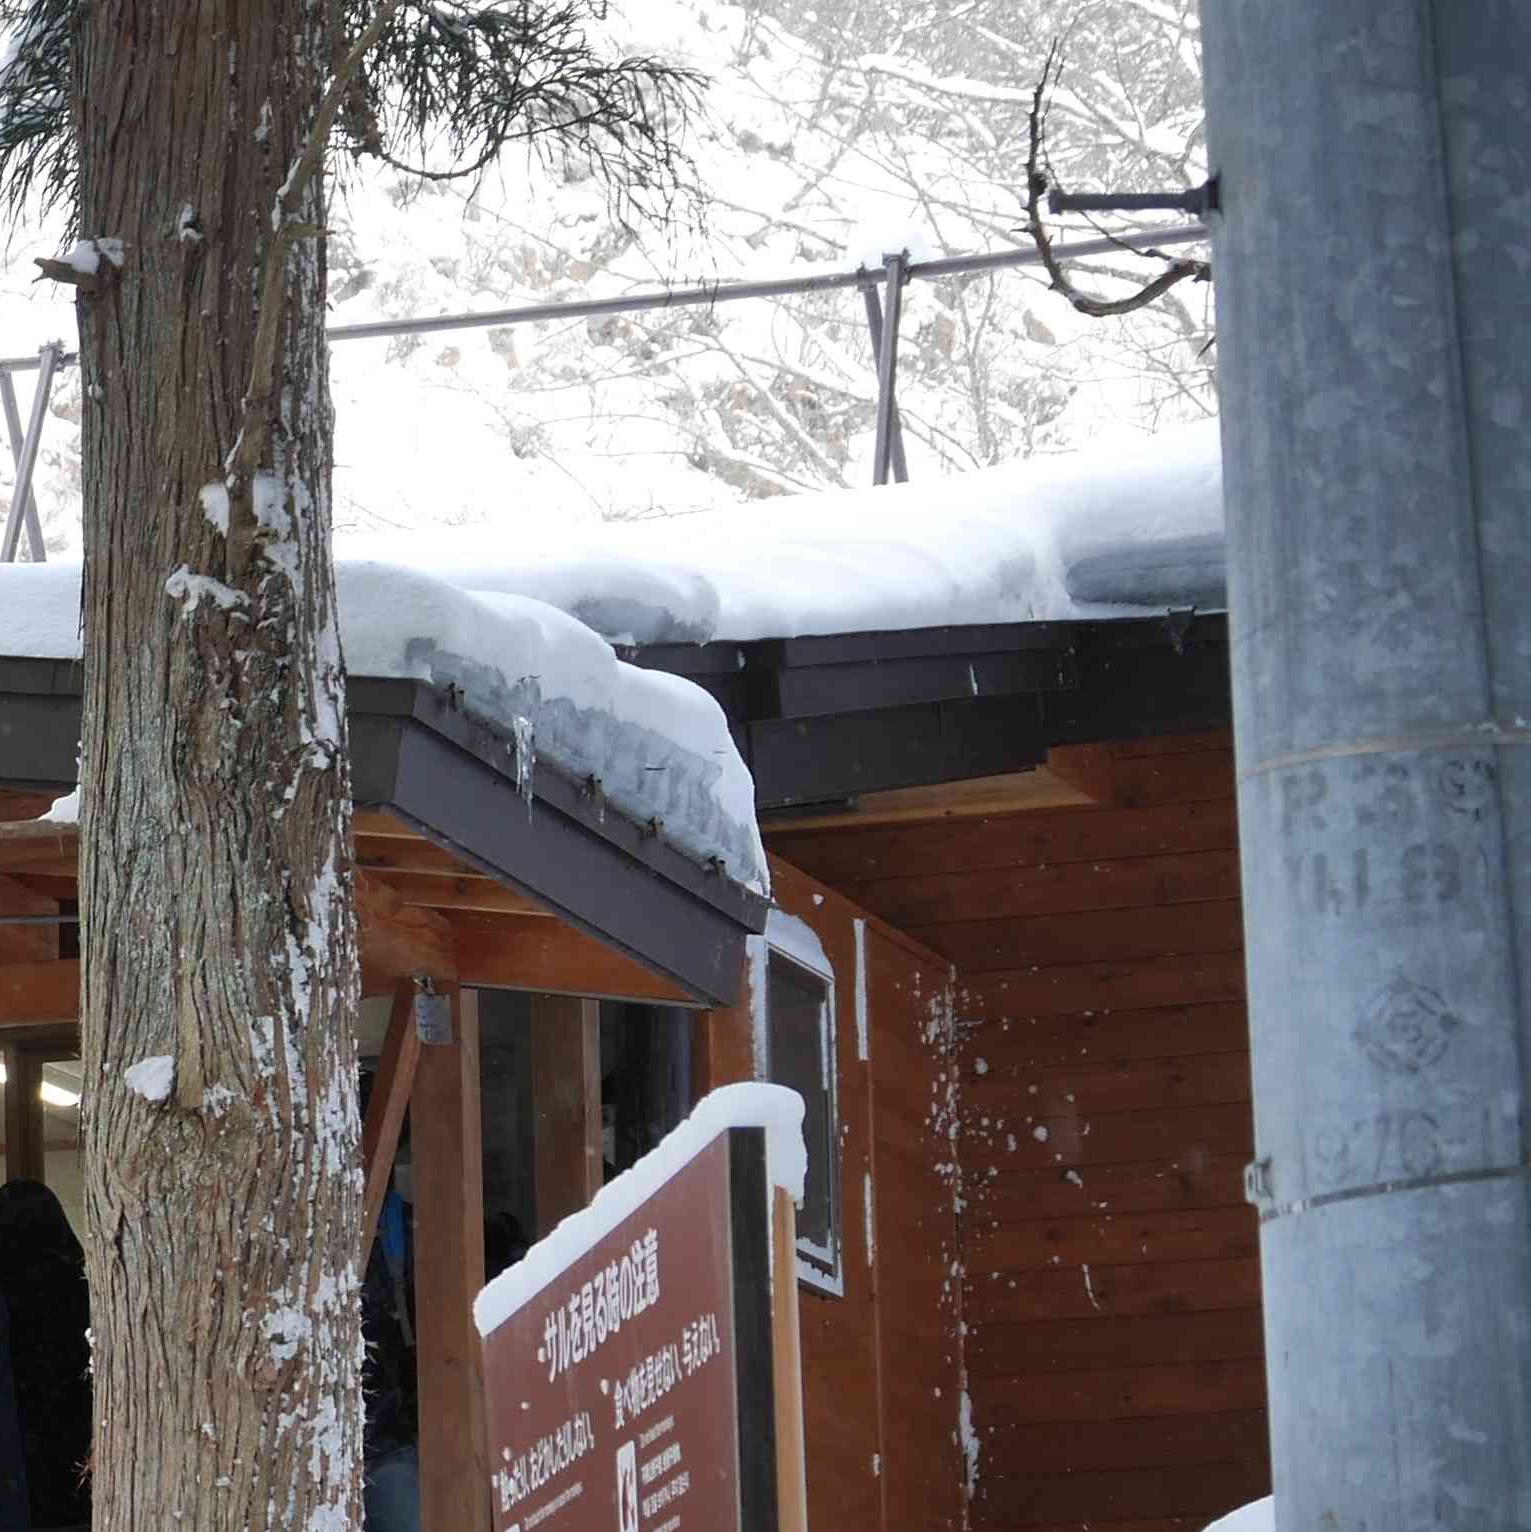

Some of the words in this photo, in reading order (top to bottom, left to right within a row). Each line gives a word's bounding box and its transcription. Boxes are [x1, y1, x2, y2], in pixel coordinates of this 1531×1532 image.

[543, 1228, 660, 1382] サルを見る時の注意
